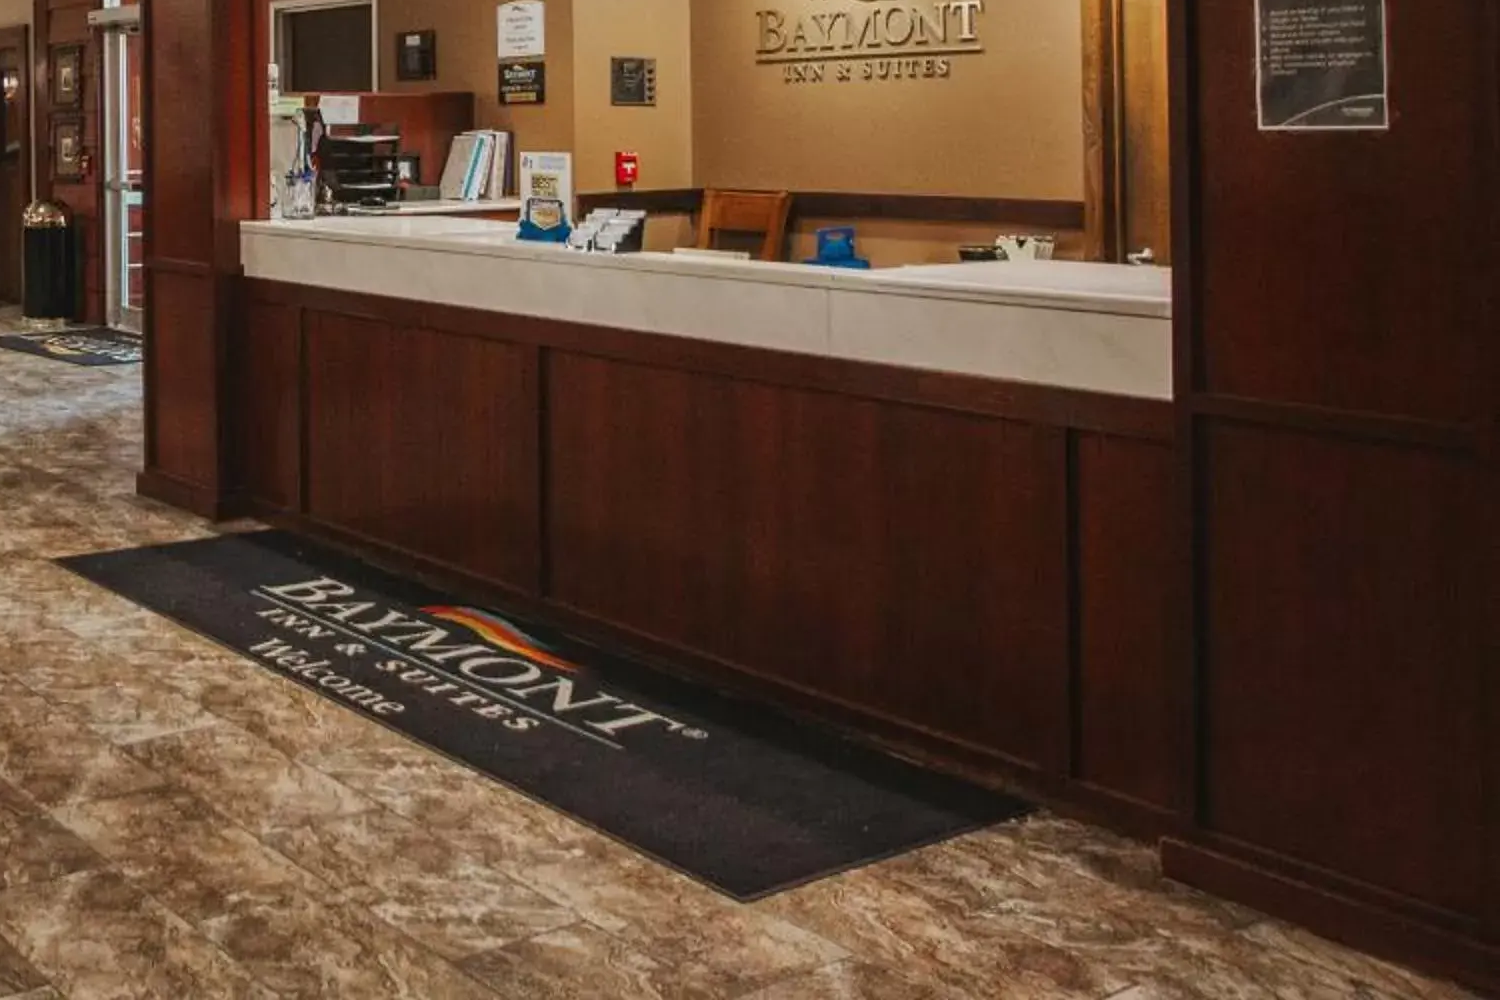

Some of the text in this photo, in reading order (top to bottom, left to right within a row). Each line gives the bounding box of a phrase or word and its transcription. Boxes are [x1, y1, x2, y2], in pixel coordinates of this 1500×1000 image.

[756, 0, 984, 55] BAYMONT
[783, 59, 950, 83] INN & SUITES
[249, 637, 405, 716] Welcome
[257, 607, 541, 732] INN & SUITES
[261, 576, 684, 736] BAYMONT
